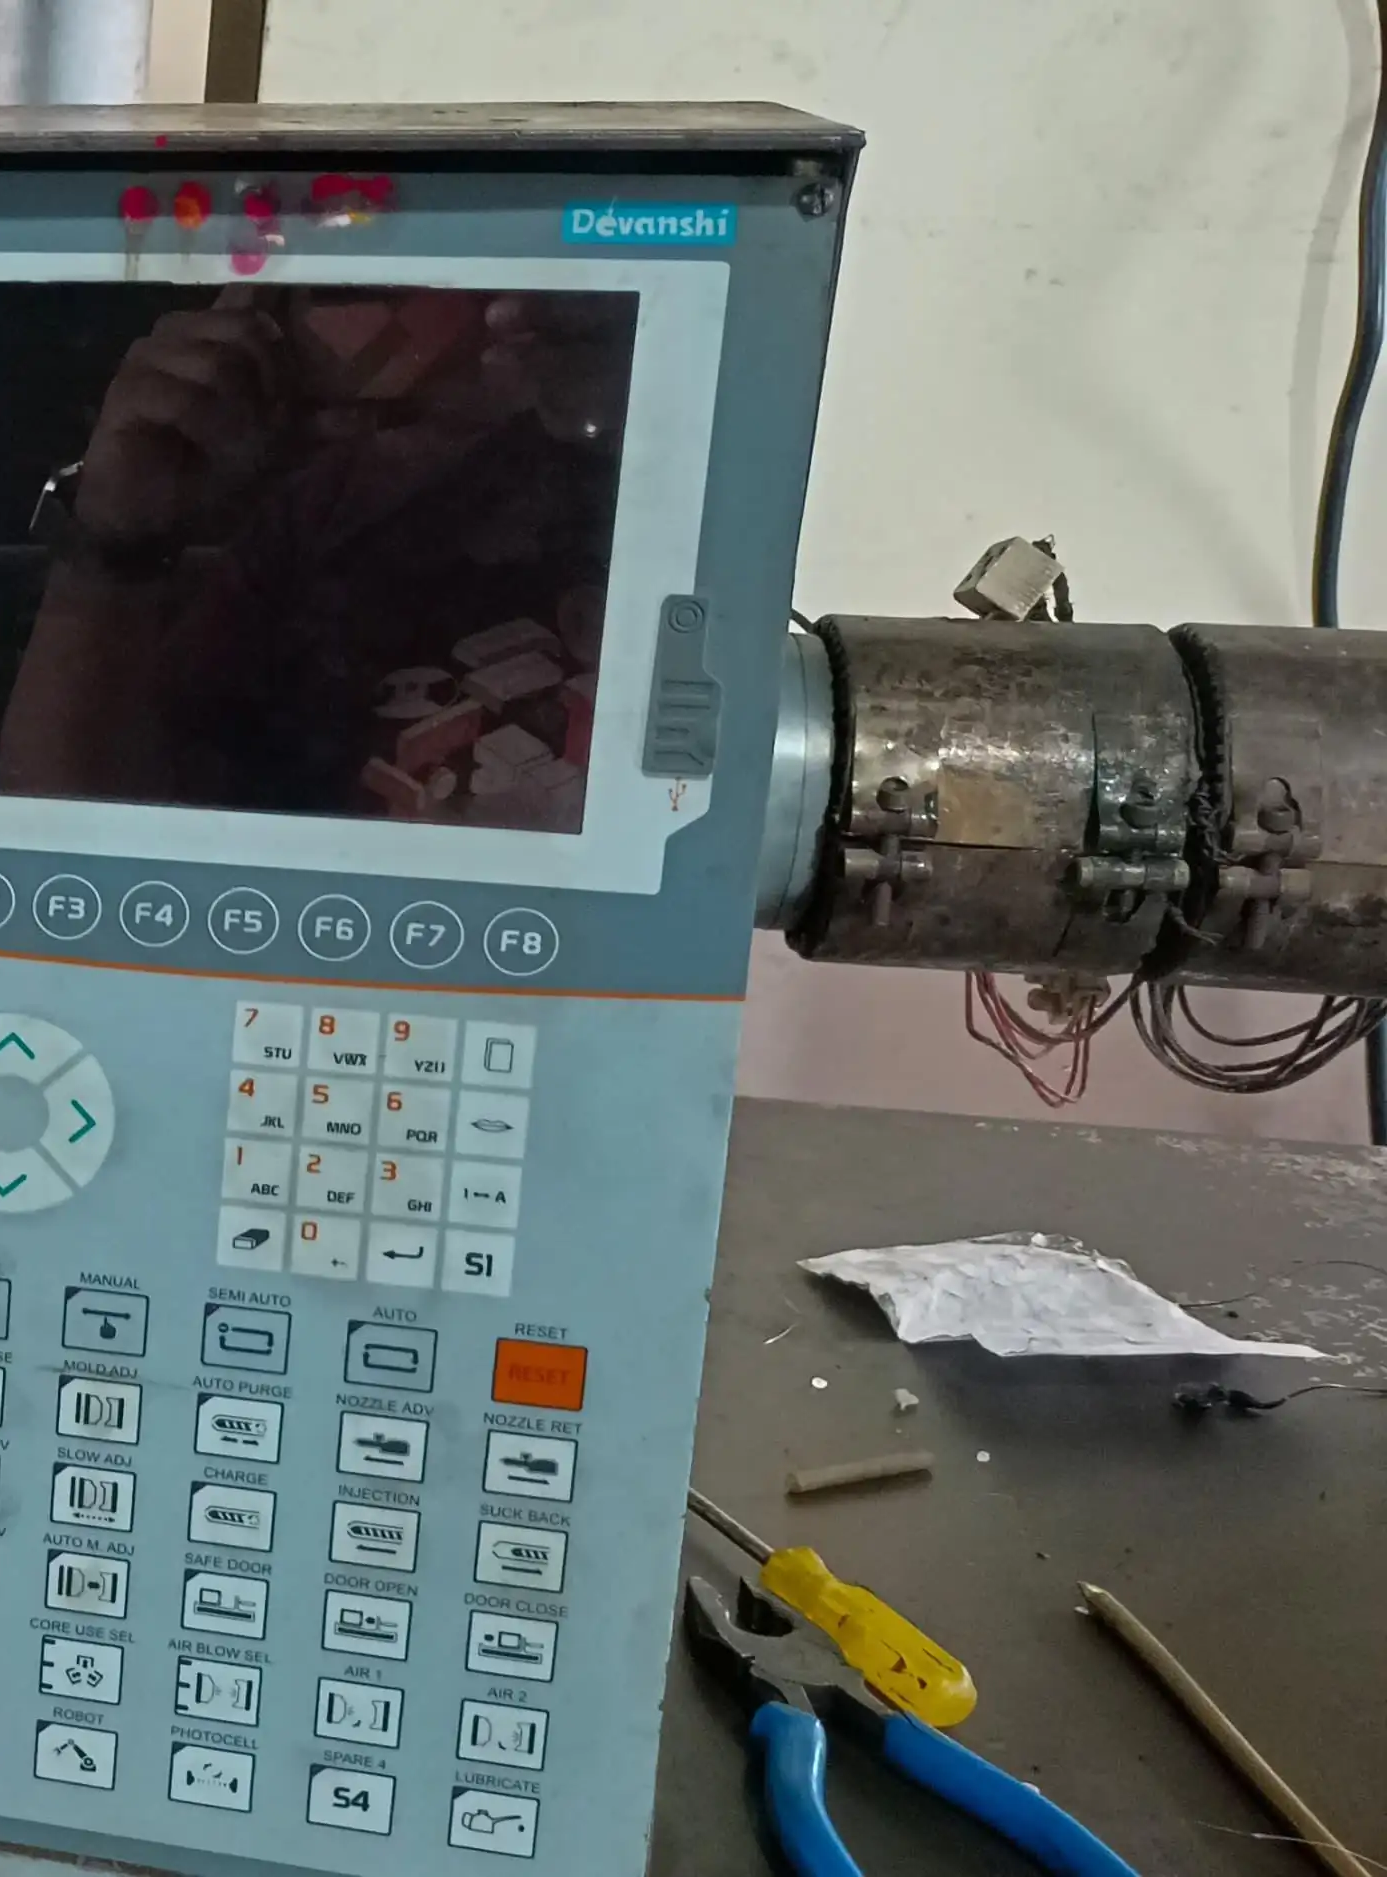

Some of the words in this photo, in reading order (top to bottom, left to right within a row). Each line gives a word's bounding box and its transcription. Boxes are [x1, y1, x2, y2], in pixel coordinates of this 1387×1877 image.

[47, 895, 86, 920] F3
[134, 902, 174, 927] F4
[223, 908, 263, 933] F5
[314, 916, 355, 941] F6
[405, 922, 446, 947] F7
[499, 929, 542, 955] F8
[243, 1007, 260, 1028] 7
[318, 1014, 336, 1036] 8
[393, 1020, 411, 1041] 9
[263, 1046, 293, 1060] STU
[332, 1051, 368, 1067] VWX
[238, 1078, 256, 1097] 4
[311, 1084, 330, 1104] 5
[386, 1091, 403, 1111] 6
[260, 1115, 285, 1130] JKL
[326, 1121, 362, 1136] MNO
[405, 1129, 439, 1144] PQR
[235, 1146, 244, 1166] 1
[306, 1154, 322, 1174] 2
[379, 1160, 398, 1181] 3
[250, 1183, 280, 1197] ABC
[326, 1189, 356, 1205] DEF
[407, 1198, 433, 1214] GHI
[301, 1221, 318, 1242] 0
[79, 1271, 141, 1290] MANUAL
[208, 1286, 246, 1303] SEMI
[248, 1292, 292, 1308] AUTO
[372, 1306, 417, 1322] AUTO
[514, 1322, 568, 1340] RESET
[63, 1359, 106, 1375] MOLD
[109, 1365, 139, 1380] ADJ
[508, 1364, 572, 1385] RESET
[192, 1375, 234, 1391] AUTO
[238, 1381, 293, 1399] PURGE
[335, 1393, 397, 1413] NOZZLE
[401, 1402, 435, 1417] ADV
[483, 1411, 545, 1432] NOZZLE
[549, 1420, 583, 1435] RET
[57, 1446, 101, 1463] SLOW
[103, 1453, 133, 1468] ADJ
[203, 1466, 268, 1486] CHARGE
[338, 1484, 421, 1507] INJECTION
[479, 1503, 523, 1521] SUCK
[527, 1509, 572, 1527] BACK
[42, 1532, 84, 1549] AUTO
[107, 1541, 136, 1556] ADJ
[184, 1552, 224, 1568] SAFE
[226, 1558, 273, 1575] DOOR
[323, 1572, 371, 1590] DOOR
[375, 1579, 419, 1597] OPEN
[463, 1592, 511, 1610] DOOR
[514, 1599, 569, 1618] CLOSE
[29, 1617, 71, 1634] CORE
[75, 1623, 105, 1639] USE
[109, 1628, 136, 1644] SEL
[167, 1638, 193, 1653] AIR
[196, 1642, 242, 1660] BLOW
[244, 1650, 272, 1664] SEL
[343, 1664, 371, 1678] AIR
[375, 1669, 382, 1681] 1
[486, 1686, 514, 1700] AIR
[517, 1690, 528, 1703] 2
[52, 1706, 104, 1725] ROBOT
[170, 1725, 260, 1750] PHOTOCELL
[323, 1749, 374, 1768] SPARE
[376, 1759, 387, 1771] 4
[455, 1770, 541, 1794] LUBRICATE
[332, 1786, 370, 1813] S4
